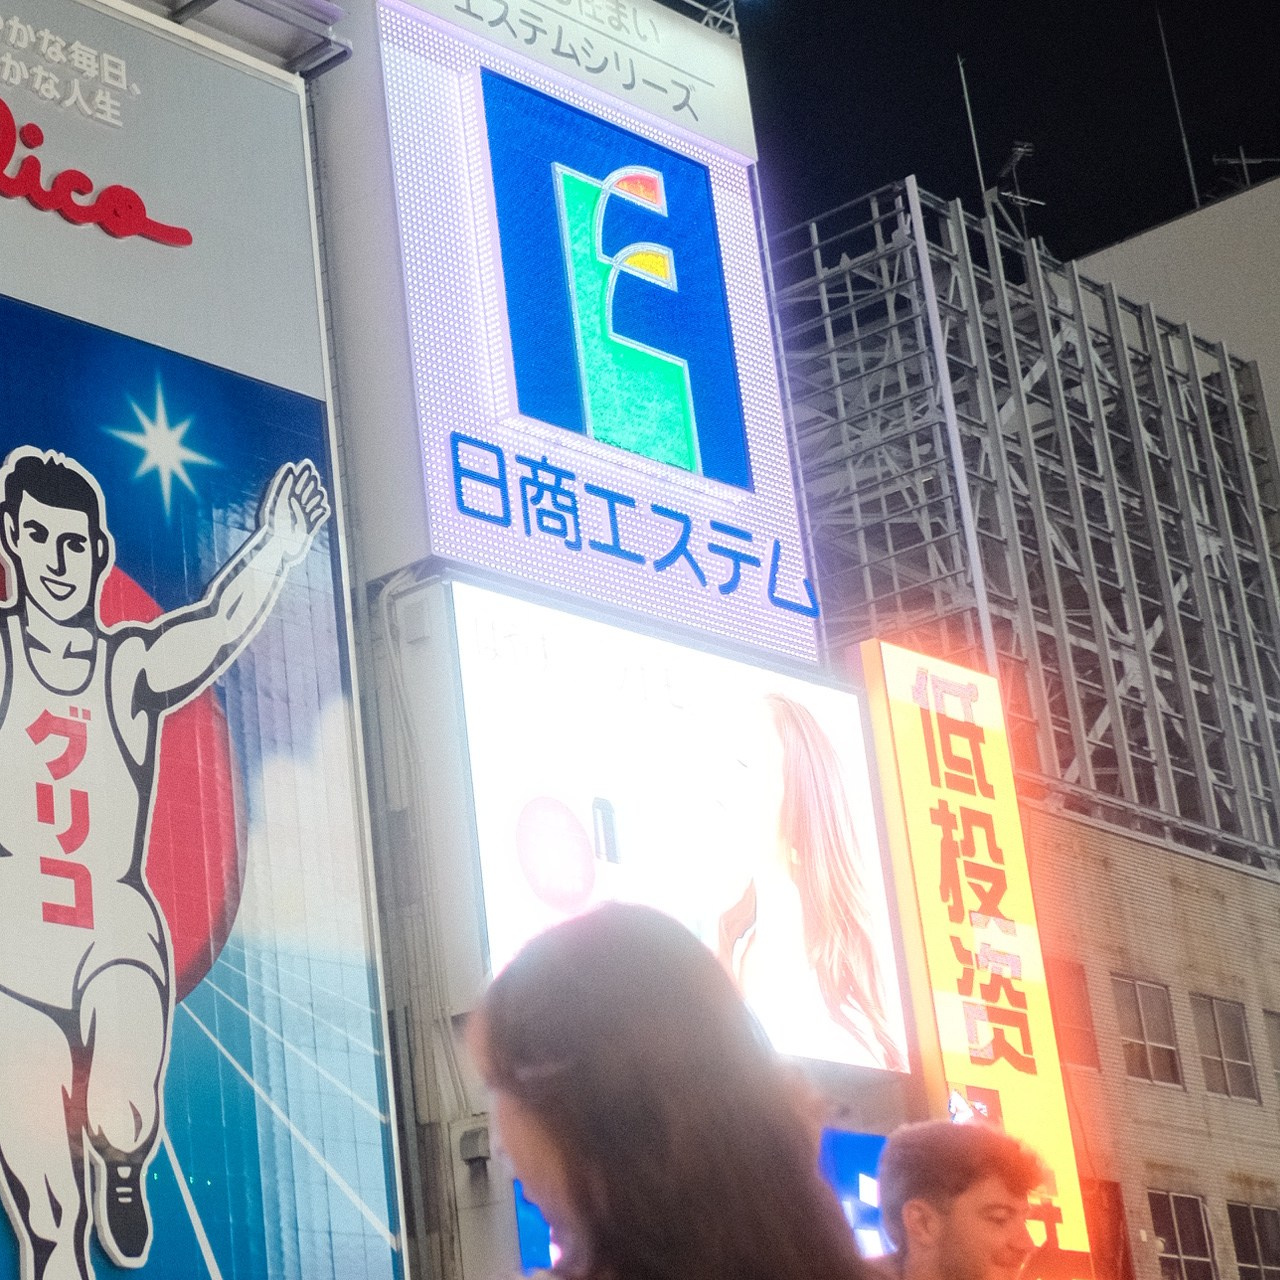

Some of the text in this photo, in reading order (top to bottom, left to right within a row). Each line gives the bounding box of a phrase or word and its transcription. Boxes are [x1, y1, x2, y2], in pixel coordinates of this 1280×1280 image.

[449, 429, 822, 620] 日商エステム
[24, 705, 95, 930] グリコ
